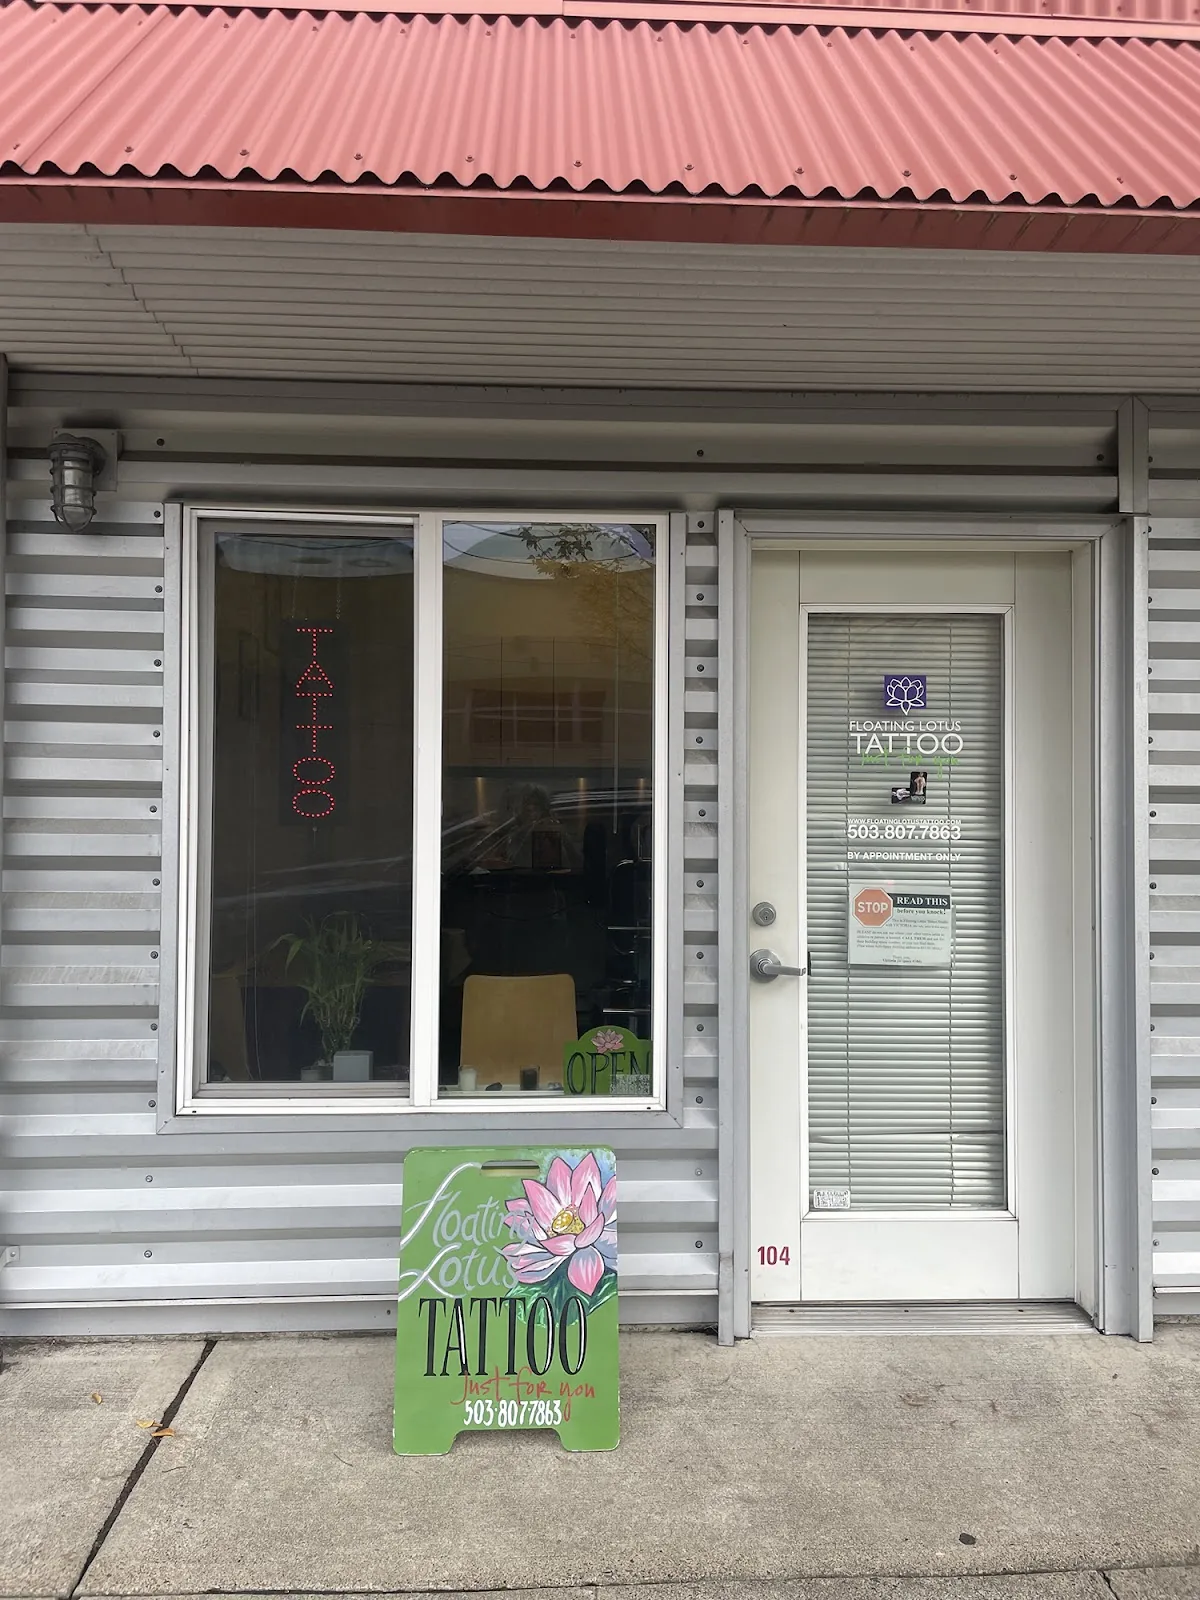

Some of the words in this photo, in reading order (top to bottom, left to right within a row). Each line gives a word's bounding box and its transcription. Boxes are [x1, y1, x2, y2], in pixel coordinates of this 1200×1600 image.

[292, 627, 336, 818] TATTOO
[849, 720, 915, 732] FLOATING
[919, 720, 962, 732] LOTUS
[850, 732, 964, 755] TATTOO
[847, 818, 962, 826] WWW.FLOATINGLOTUSTATTOO.COM
[847, 824, 962, 841] 503.807.7863
[847, 851, 861, 861] BY
[862, 851, 934, 861] APPOINTMENT
[935, 852, 961, 862] ONLY
[858, 902, 888, 913] STOP
[896, 896, 923, 906] READ
[924, 897, 948, 906] THIS
[566, 1050, 652, 1095] OPEN
[757, 1245, 791, 1266] 104
[398, 1242, 520, 1299] Lotus
[418, 1296, 588, 1377] TATTOO
[559, 1381, 596, 1423] you
